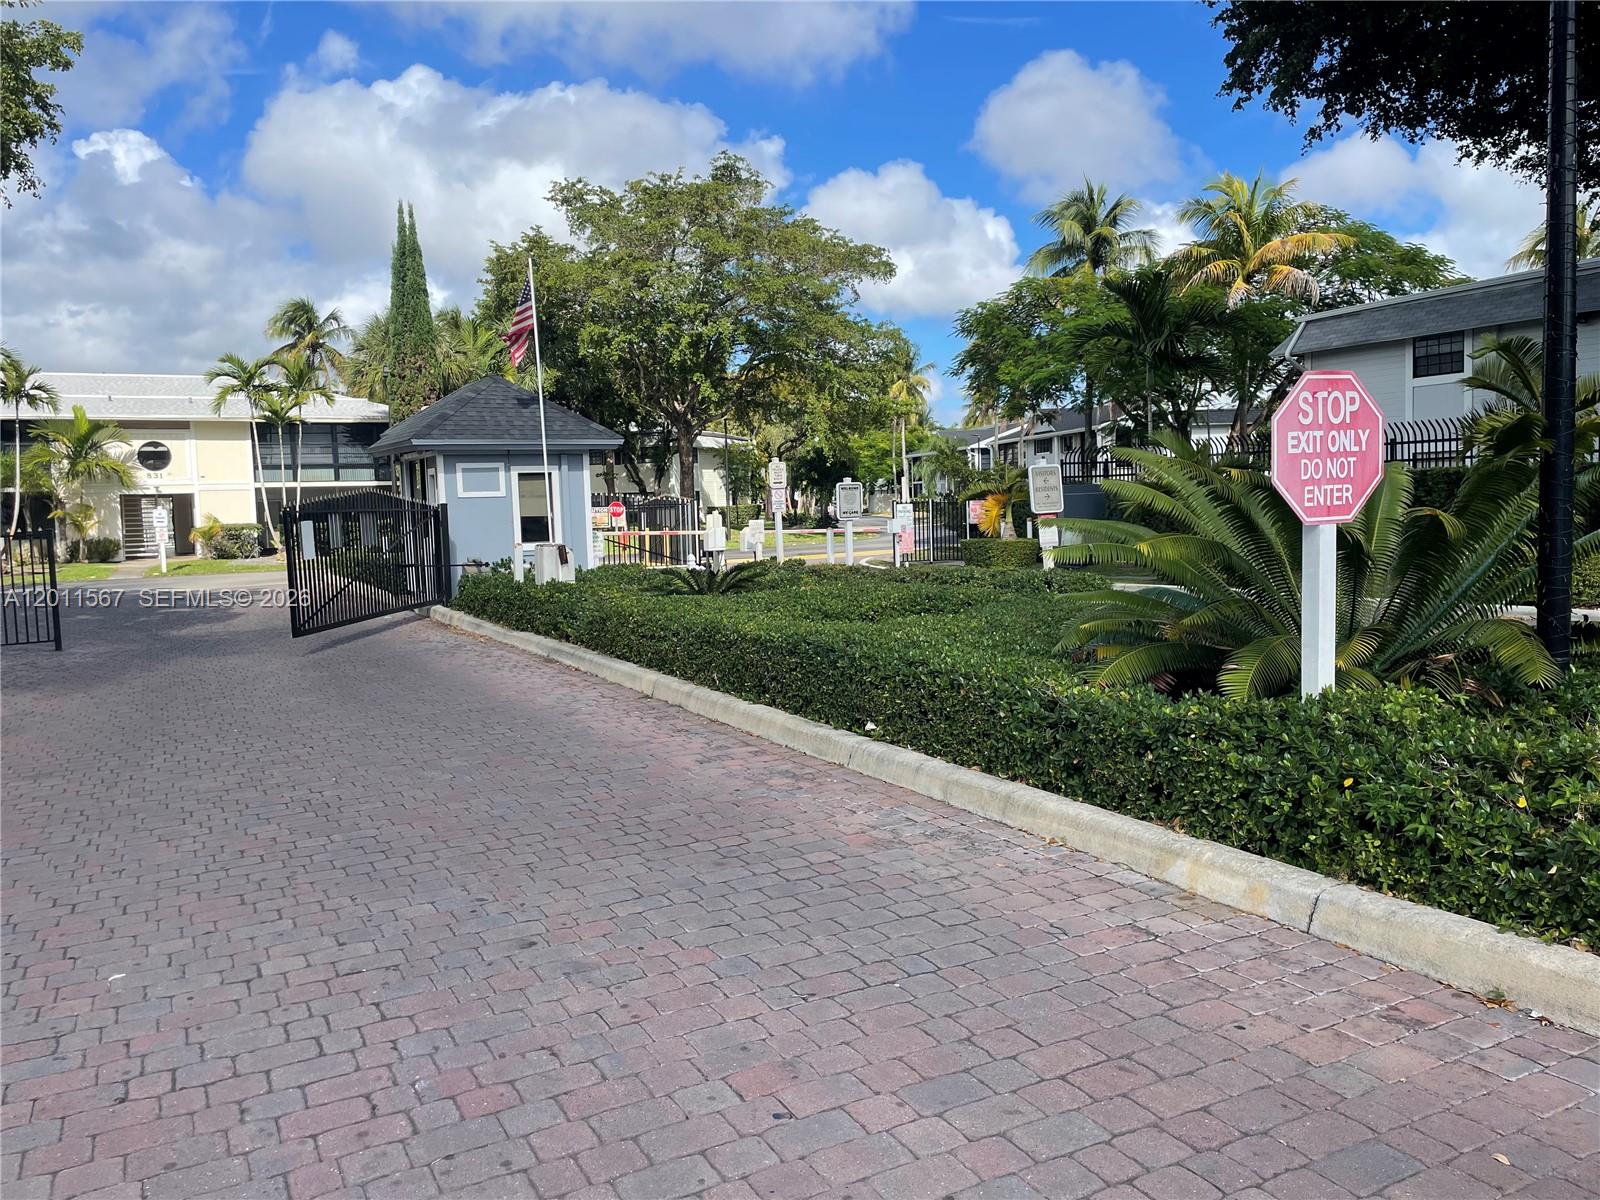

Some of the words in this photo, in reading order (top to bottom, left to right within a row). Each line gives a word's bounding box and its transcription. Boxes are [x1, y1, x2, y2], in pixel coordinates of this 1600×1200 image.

[1298, 391, 1359, 424] STOP
[1287, 430, 1324, 454] EXIT
[1327, 429, 1370, 453] ONLY
[1300, 458, 1323, 480] DO
[1326, 457, 1357, 479] NOT
[1304, 484, 1353, 507] ENTER
